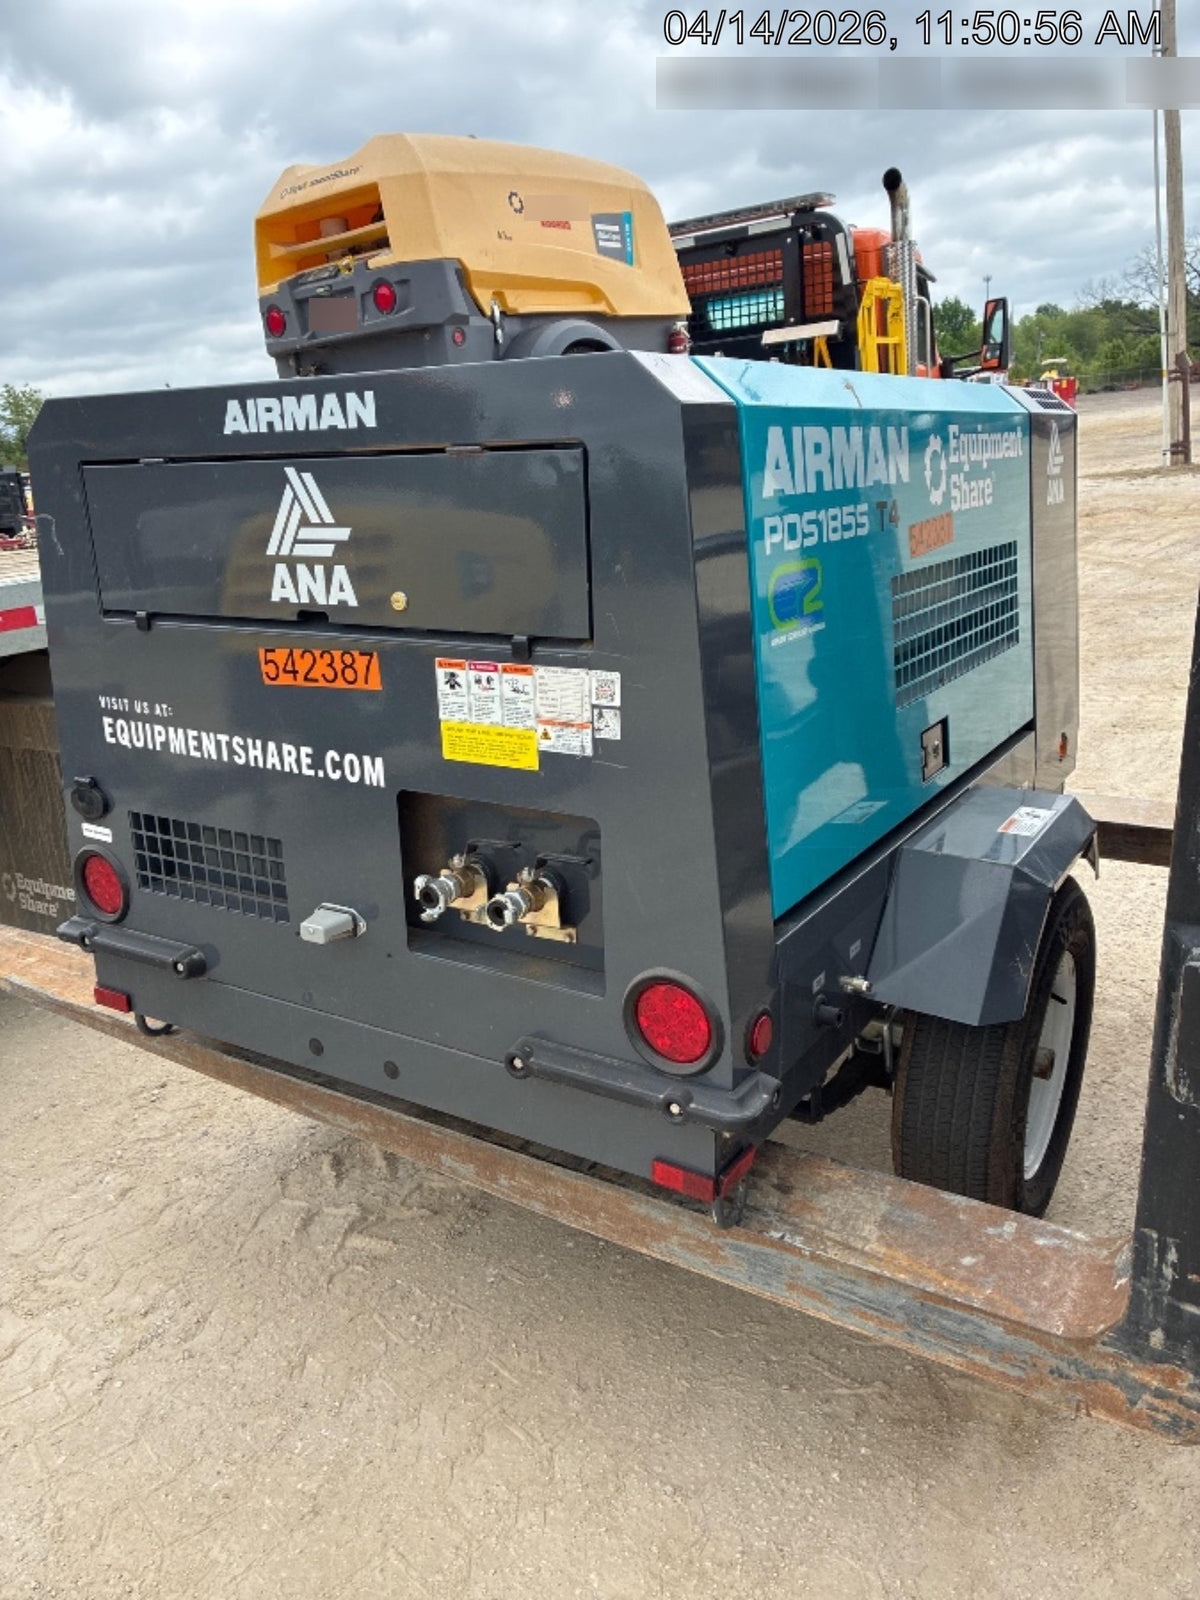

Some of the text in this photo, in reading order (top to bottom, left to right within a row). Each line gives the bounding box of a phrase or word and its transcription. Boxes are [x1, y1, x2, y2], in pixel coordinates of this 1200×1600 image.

[223, 390, 377, 435] AIRMAN
[762, 425, 910, 498] AIRMAN
[948, 424, 1023, 472] Equipment
[949, 474, 993, 512] Share
[1046, 477, 1065, 506] ANA
[764, 499, 900, 556] PDS185S T4
[270, 562, 359, 607] ANA
[263, 648, 375, 686] 542387
[99, 695, 174, 717] VISIT US AT:
[102, 716, 386, 788] EQUIPMENTSHARE.COM
[16, 873, 76, 902] Equipme
